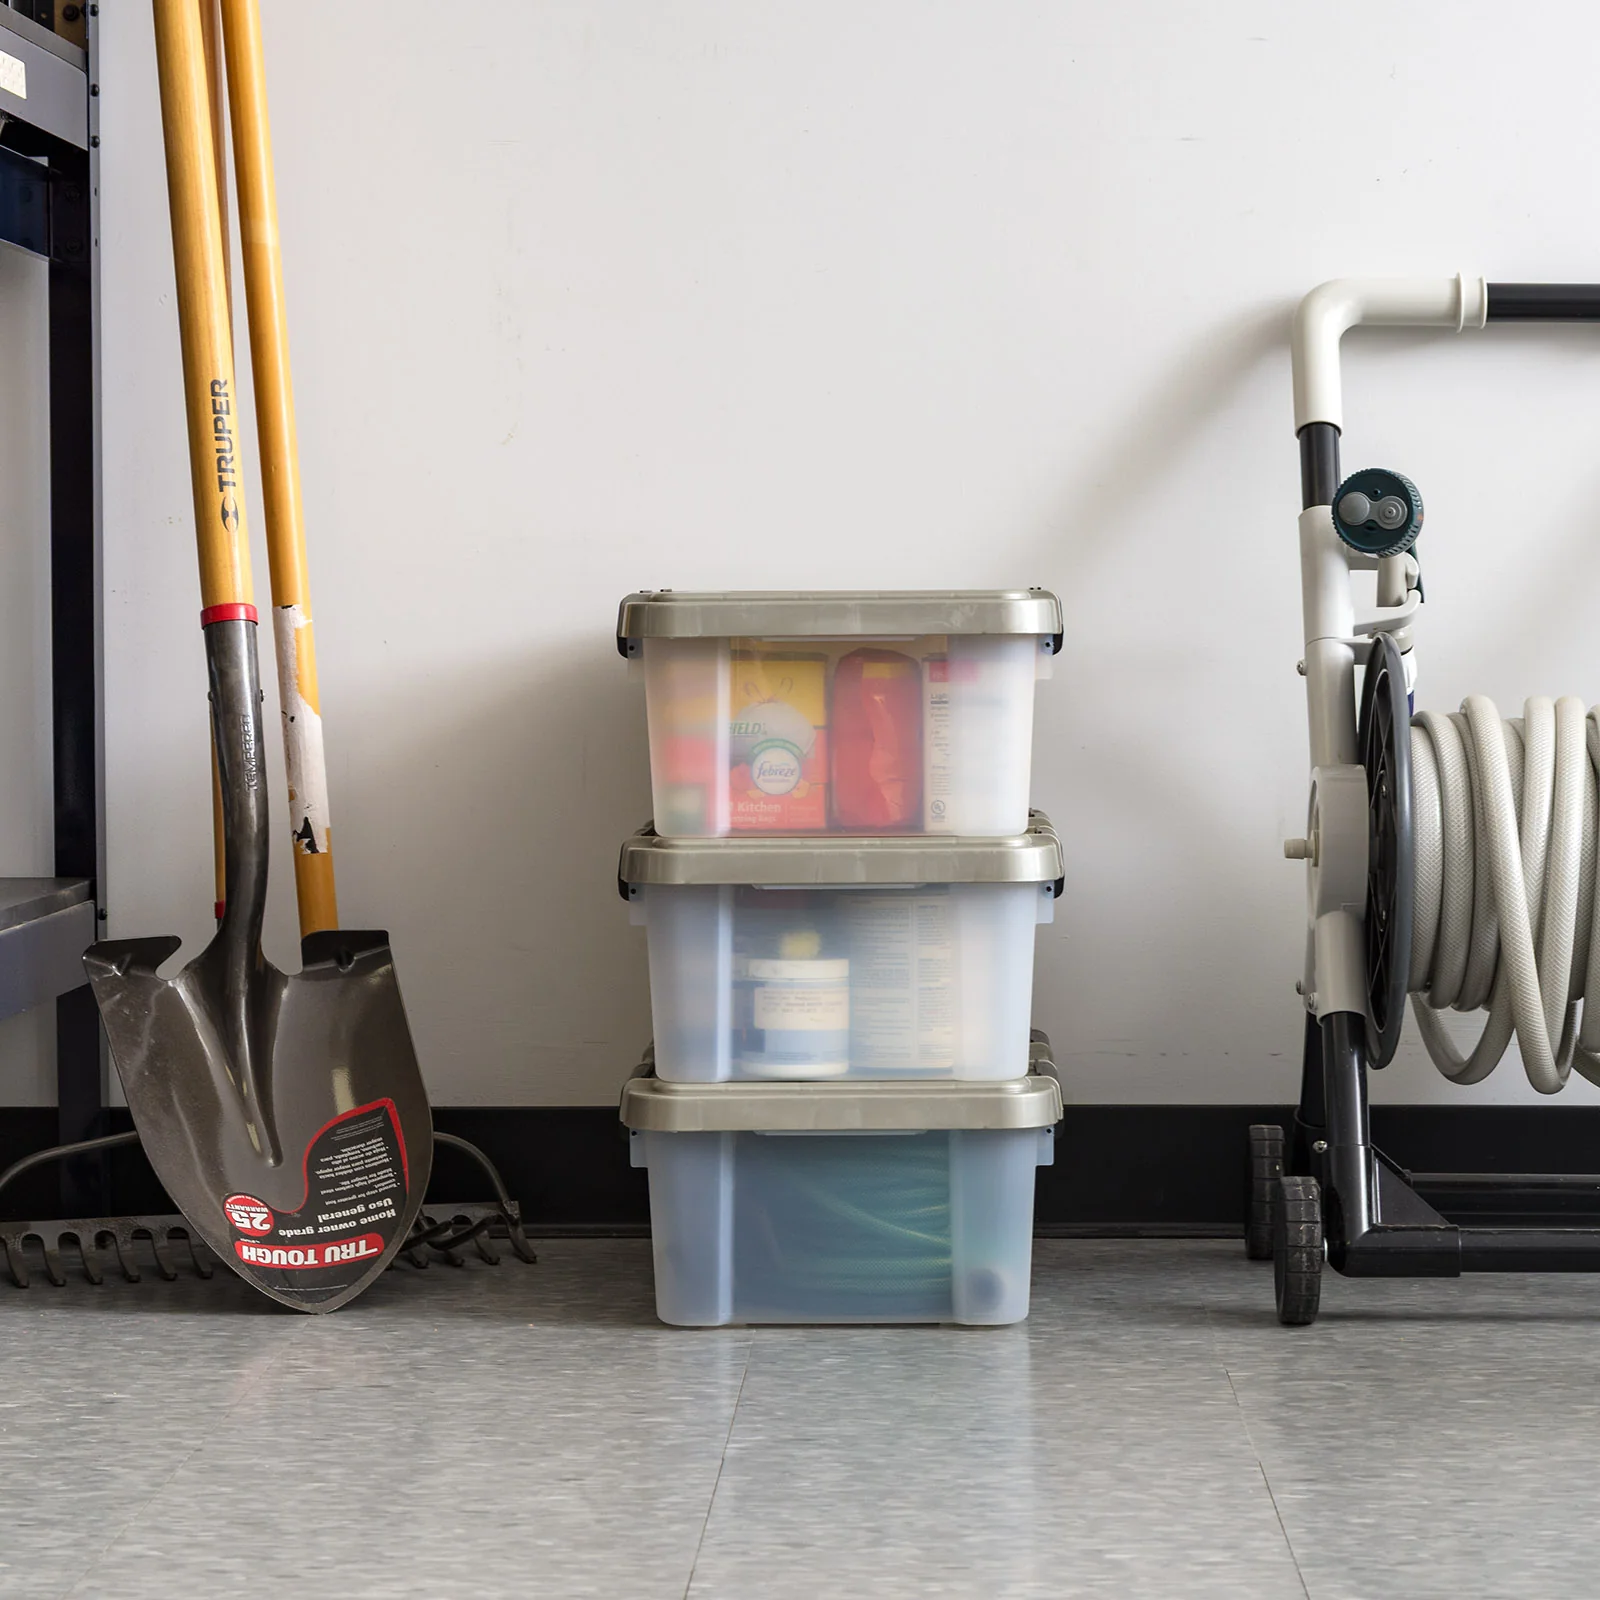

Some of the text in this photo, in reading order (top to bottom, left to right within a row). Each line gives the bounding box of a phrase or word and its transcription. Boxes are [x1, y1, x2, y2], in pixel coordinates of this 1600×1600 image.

[210, 379, 236, 493] TRUPER
[240, 714, 258, 792] TEMPERED
[738, 801, 781, 812] Kitchen
[367, 1172, 393, 1183] Tempered
[225, 1203, 268, 1212] WARRANTY
[230, 1210, 270, 1229] 25
[317, 1198, 392, 1222] Uso general
[278, 1208, 395, 1237] Home owner grade
[242, 1239, 377, 1265] TRU TOUGH
